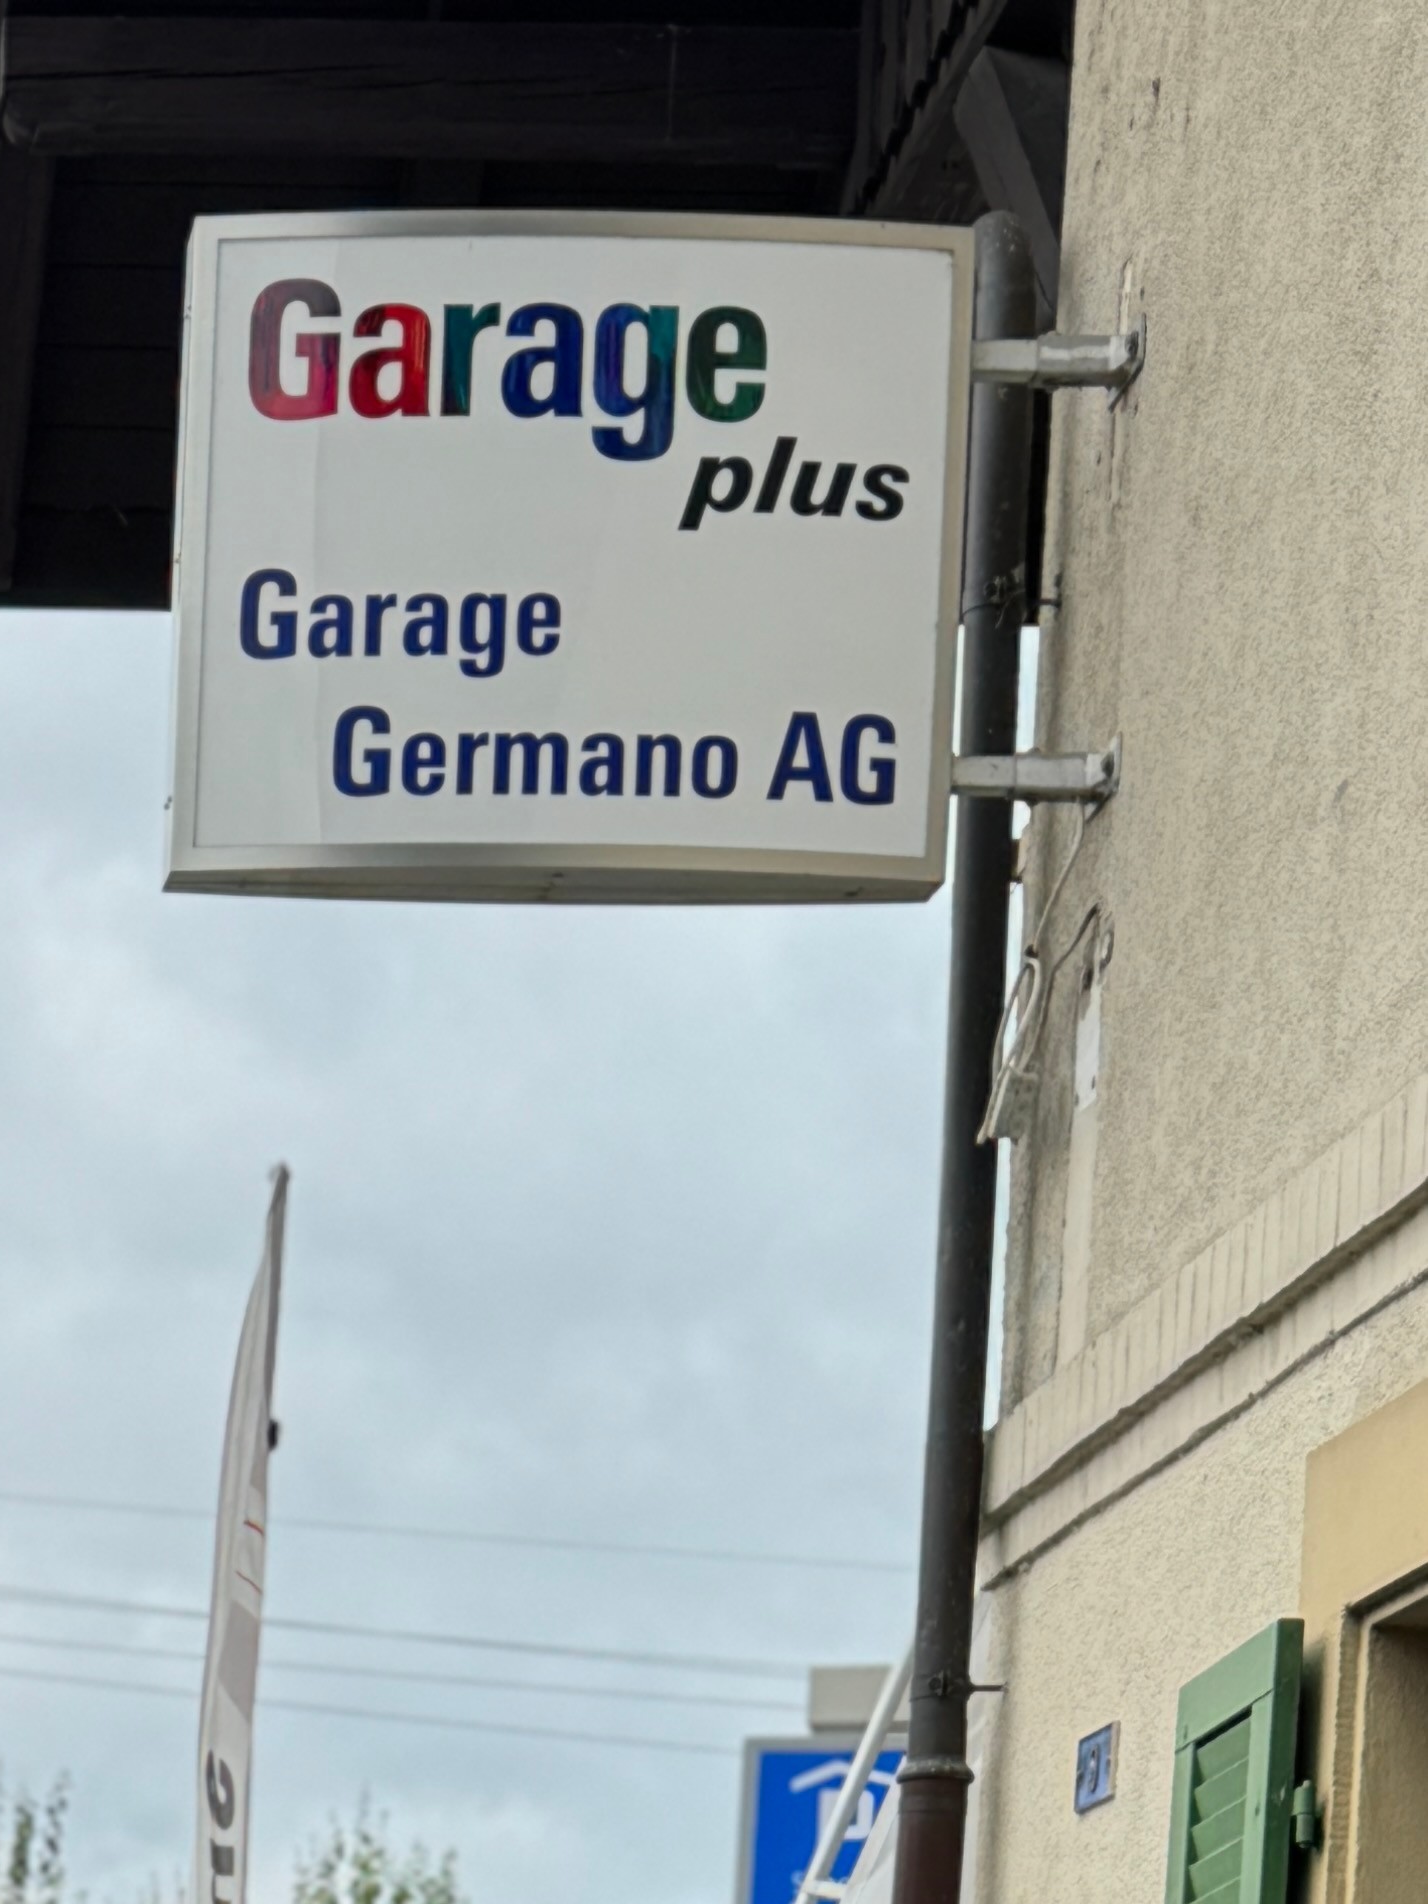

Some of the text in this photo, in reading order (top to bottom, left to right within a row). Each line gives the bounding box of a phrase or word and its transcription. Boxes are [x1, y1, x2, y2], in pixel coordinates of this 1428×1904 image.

[248, 278, 768, 462] Garage
[677, 436, 910, 531] plus
[239, 568, 562, 678] Garage
[332, 705, 897, 807] Germano AG
